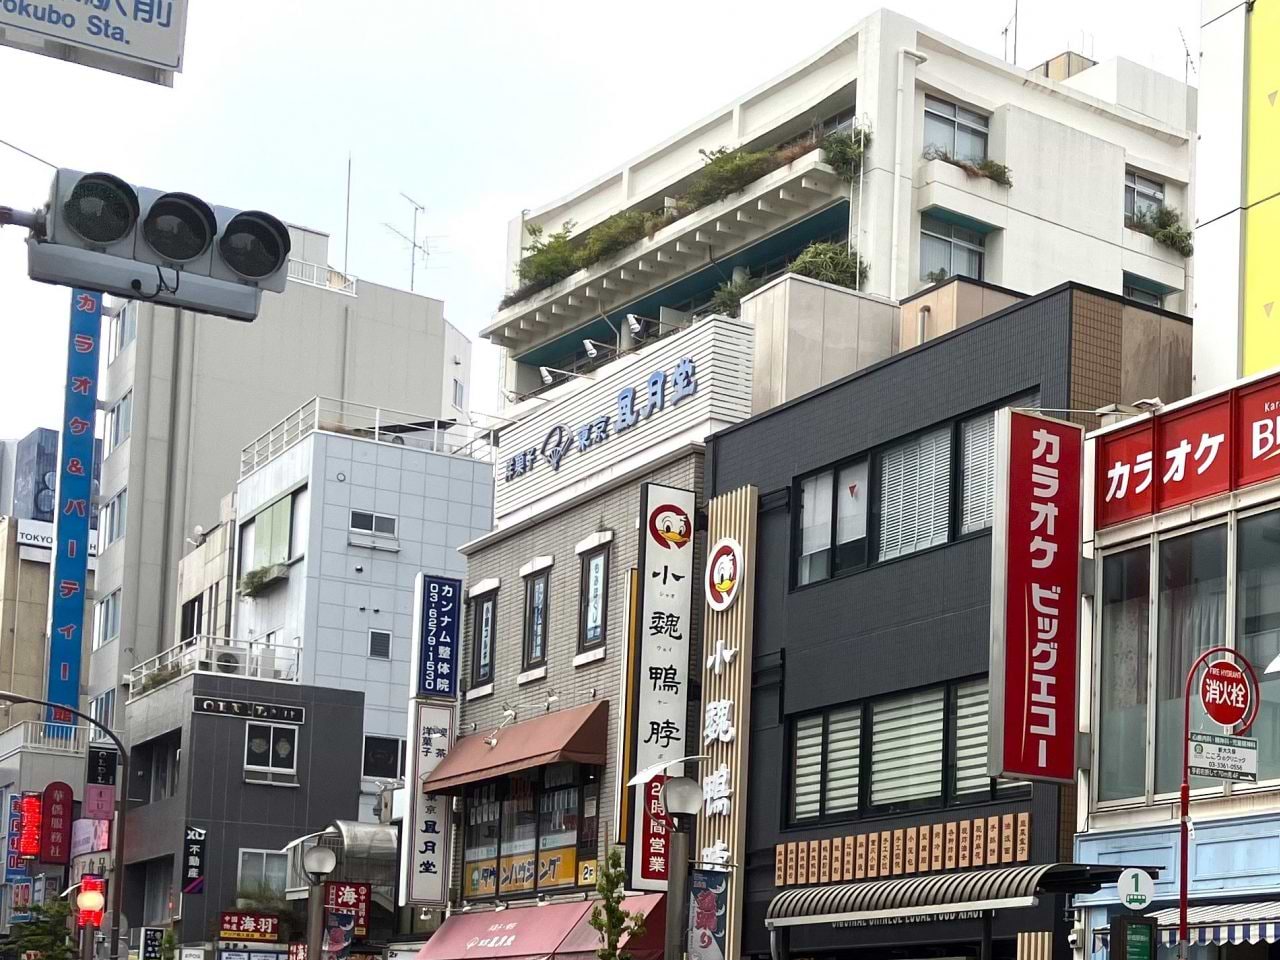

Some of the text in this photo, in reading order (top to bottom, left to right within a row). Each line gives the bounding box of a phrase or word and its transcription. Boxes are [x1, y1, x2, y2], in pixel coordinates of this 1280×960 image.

[0, 0, 130, 44] okubo Sta.
[577, 415, 610, 452] 東京
[1105, 431, 1225, 503] カラオケ
[19, 532, 53, 545] TOKYO
[1030, 428, 1062, 768] カラオケ ビッグエコー
[424, 584, 438, 690] 03-6279-1530
[437, 584, 453, 692] カンナム整体院
[1205, 678, 1246, 708] 消火栓
[421, 726, 433, 757] 洋菓子
[648, 782, 666, 873] 2時間営業
[187, 844, 201, 879] 不動産
[583, 864, 594, 880] 2F
[1131, 873, 1139, 893] 1
[240, 915, 273, 932] 海羽
